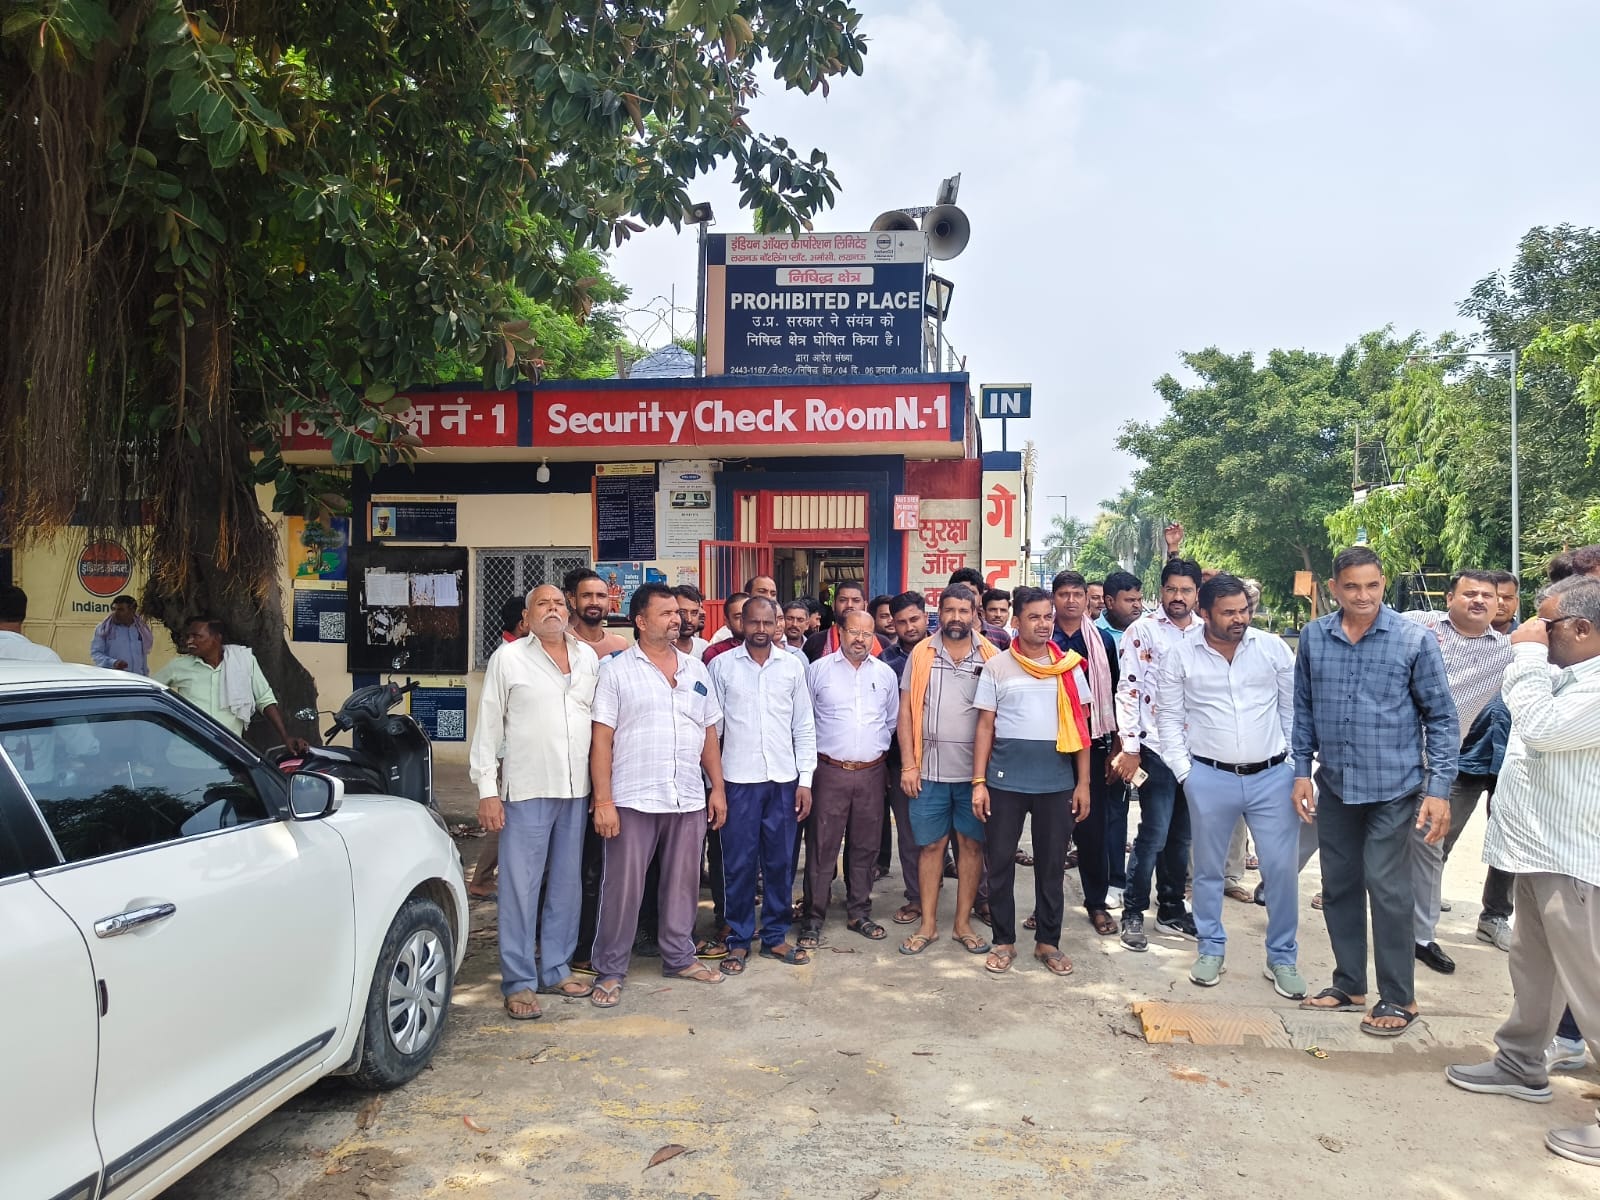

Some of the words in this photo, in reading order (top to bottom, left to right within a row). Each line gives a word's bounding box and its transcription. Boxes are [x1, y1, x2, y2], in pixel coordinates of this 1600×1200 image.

[788, 269, 834, 284] निषिद्ध
[838, 269, 862, 283] क्षेत्र
[731, 292, 850, 310] PROHIBITED
[857, 291, 921, 309] PLACE
[786, 315, 825, 328] सरकार
[831, 313, 839, 327] ने
[880, 312, 895, 327] को
[747, 332, 782, 347] निषिद्ध
[788, 332, 807, 346] क्षेत्र
[813, 332, 846, 347] घोषित
[852, 332, 879, 346] किया
[990, 393, 1020, 413] IN
[548, 401, 688, 443] Security
[694, 400, 798, 433] Check
[898, 511, 917, 528] 15
[919, 519, 971, 549] सुरक्षा
